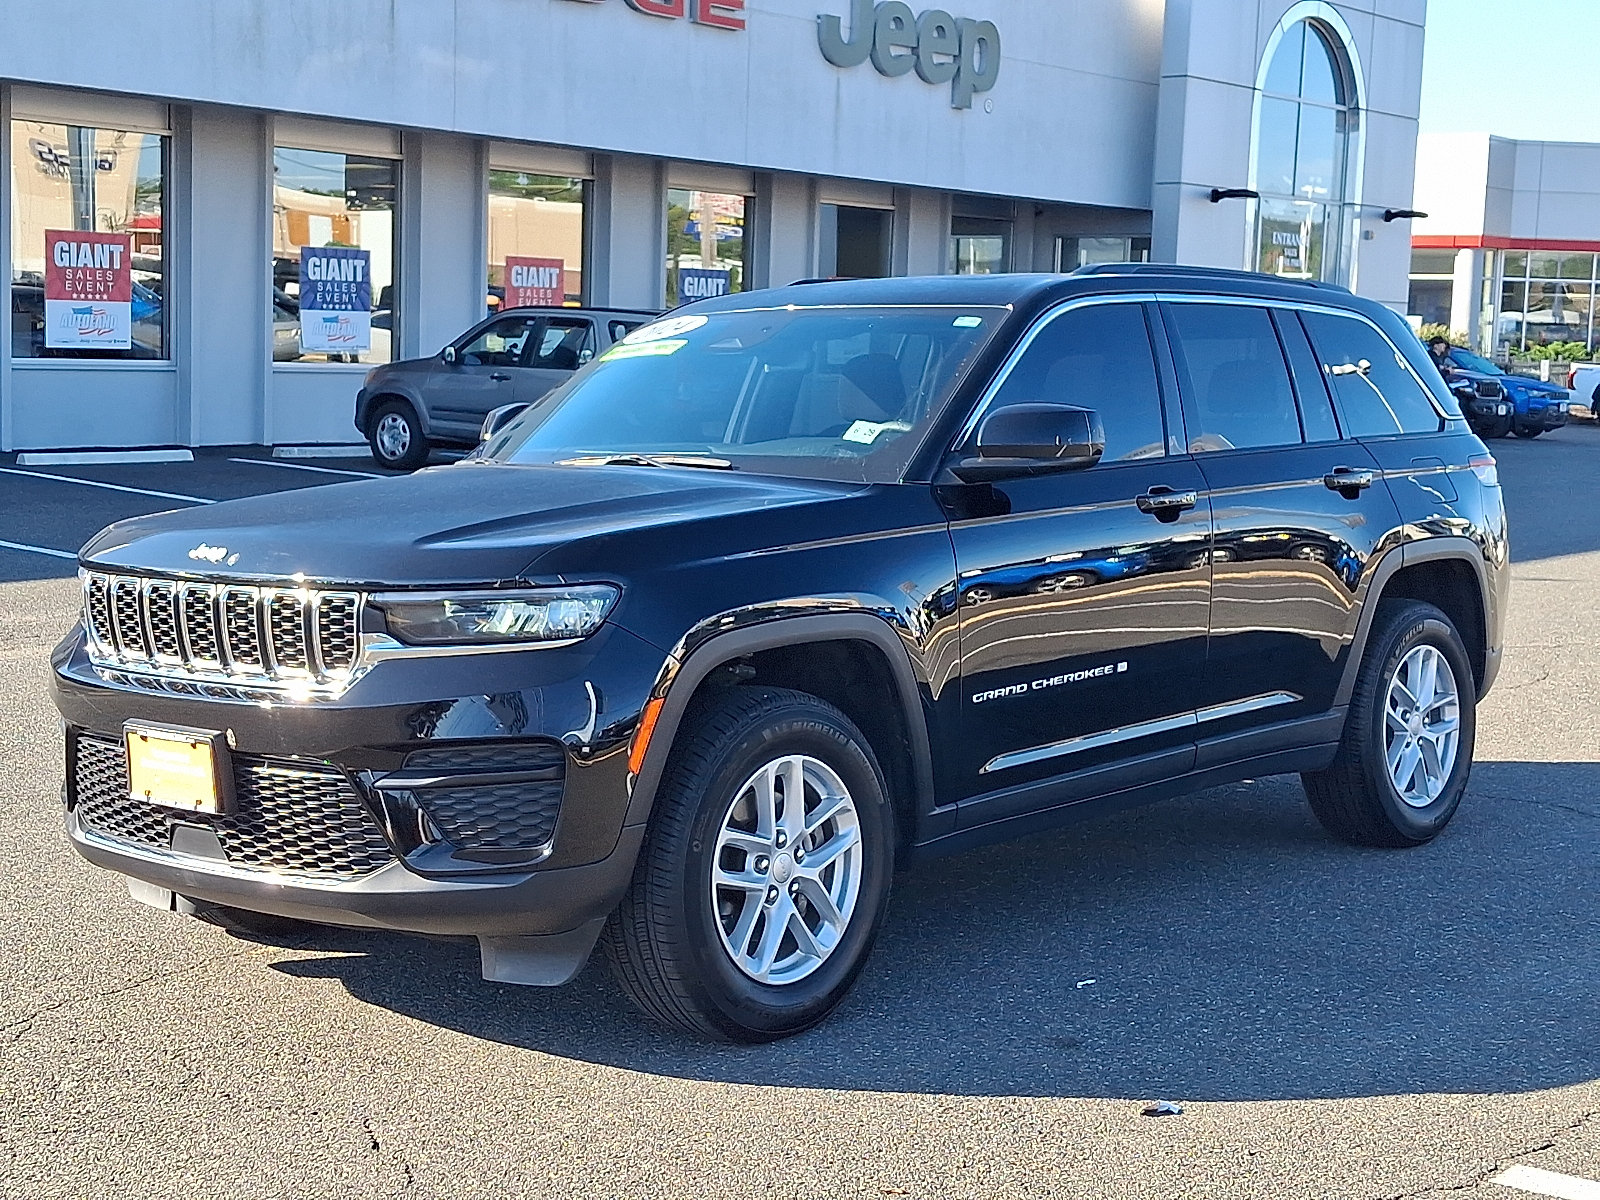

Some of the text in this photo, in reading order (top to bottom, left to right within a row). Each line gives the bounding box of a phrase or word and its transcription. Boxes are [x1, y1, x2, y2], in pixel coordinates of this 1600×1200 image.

[818, 0, 1001, 109] Jeep
[54, 240, 125, 269] GIANT
[65, 268, 114, 281] SALES
[307, 256, 366, 283] GIANT
[510, 264, 560, 289] GIANT
[65, 280, 115, 293] EVENT
[316, 292, 358, 303] EVENT
[317, 281, 357, 293] SALES
[519, 288, 553, 298] SALES
[683, 276, 726, 297] GIANT
[972, 664, 1114, 704] GRAND CHEROKEE
[791, 721, 849, 746] MICHELIN
